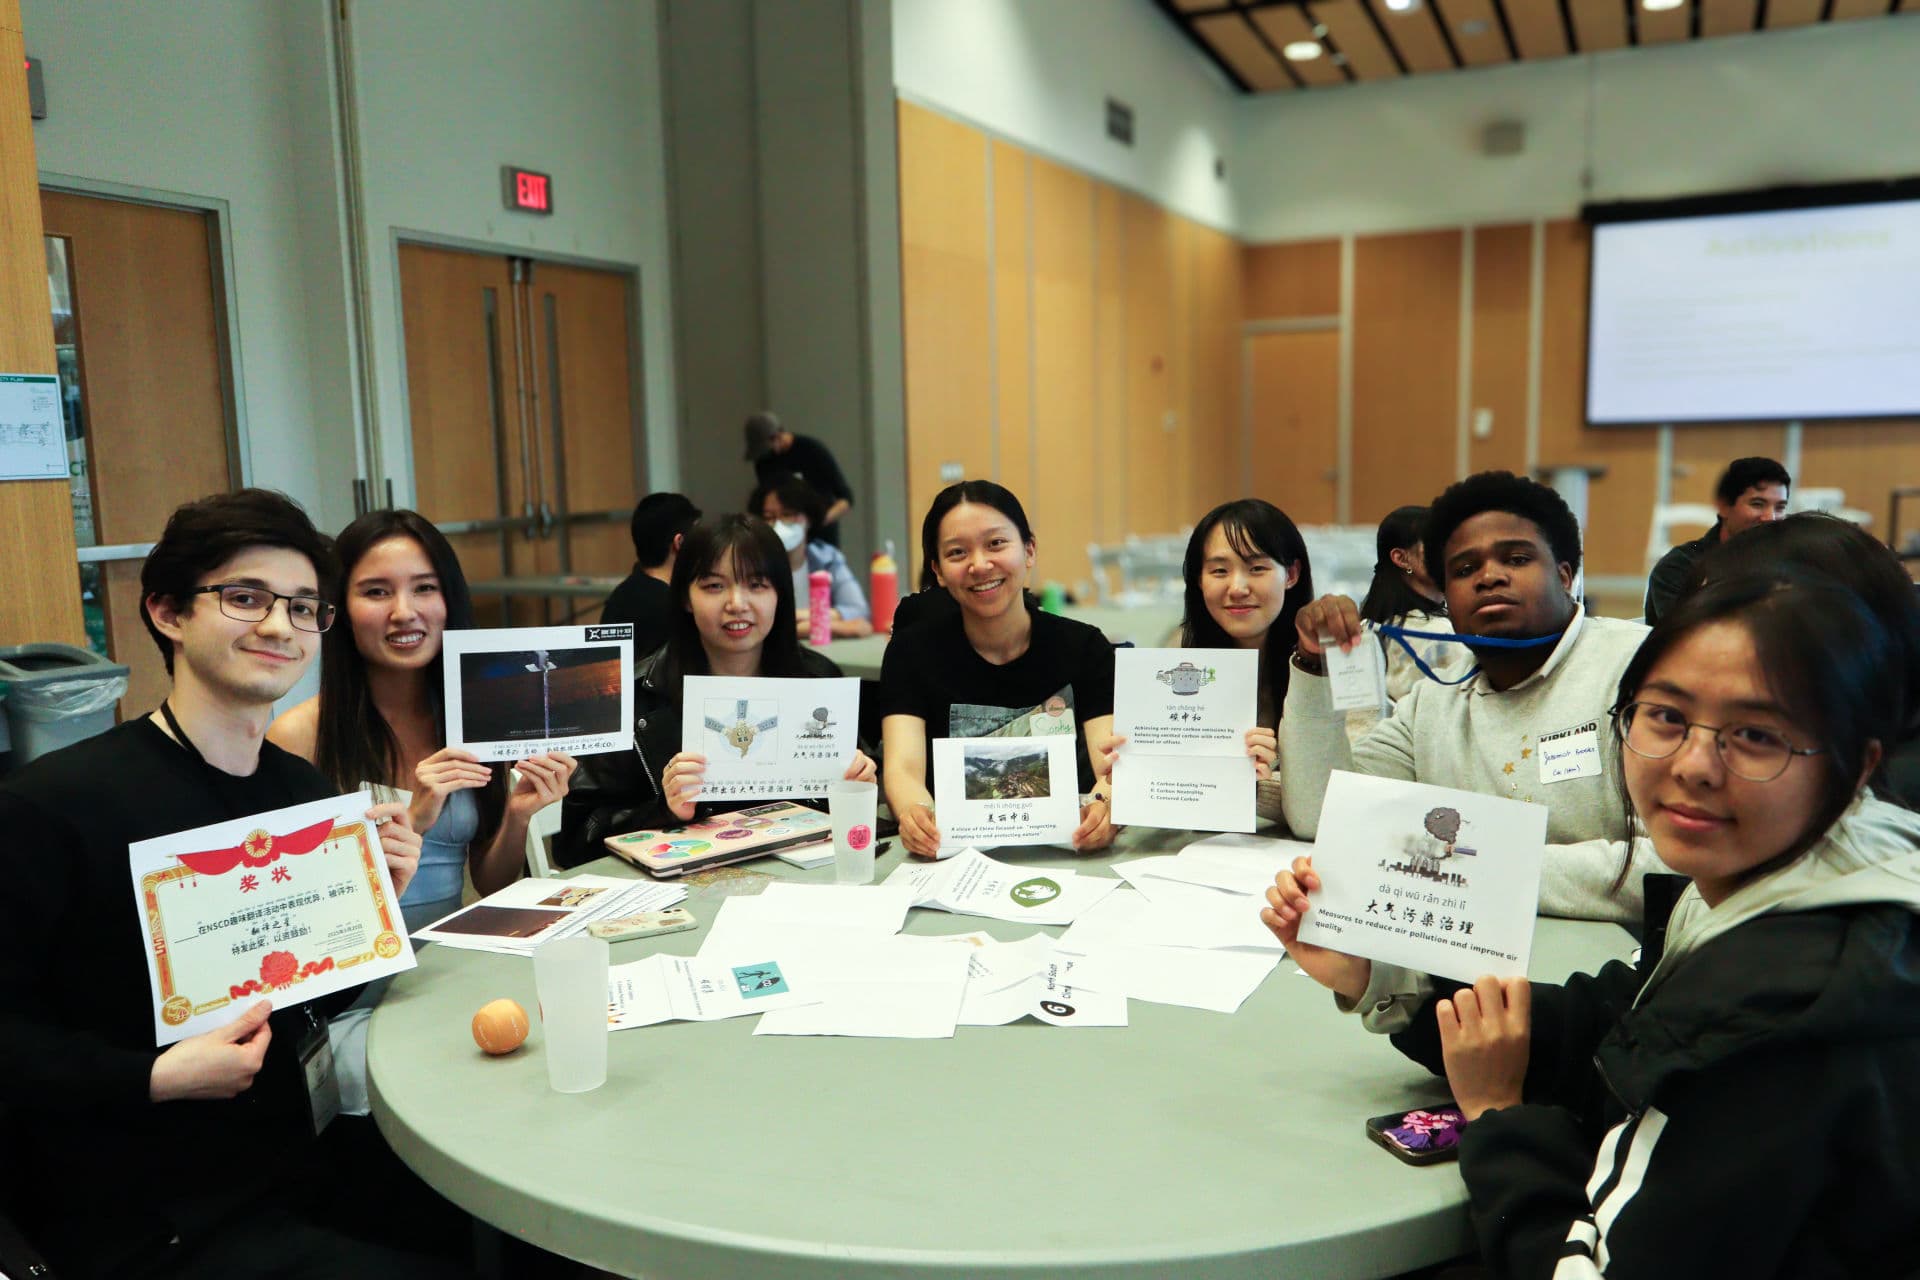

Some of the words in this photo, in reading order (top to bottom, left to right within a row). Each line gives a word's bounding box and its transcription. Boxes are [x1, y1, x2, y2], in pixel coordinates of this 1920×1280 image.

[516, 172, 547, 209] EXIT
[1169, 711, 1202, 723] 碳中和
[987, 812, 1030, 823] 美丽中国
[239, 865, 292, 894] 奖状
[1379, 884, 1391, 894] dà
[1393, 886, 1403, 899] qì
[1405, 888, 1420, 900] wū
[1422, 892, 1439, 905] rǎn
[1442, 896, 1457, 909] zhì
[1315, 919, 1344, 934] quality.
[1365, 899, 1474, 935] 大气污染治理
[1318, 907, 1353, 922] Measures
[1354, 917, 1363, 925] to
[1365, 919, 1393, 932] reduce
[1394, 925, 1407, 935] air
[1409, 928, 1448, 944] pollution
[1450, 938, 1467, 949] and
[1470, 943, 1505, 958] improve
[1506, 952, 1518, 962] air
